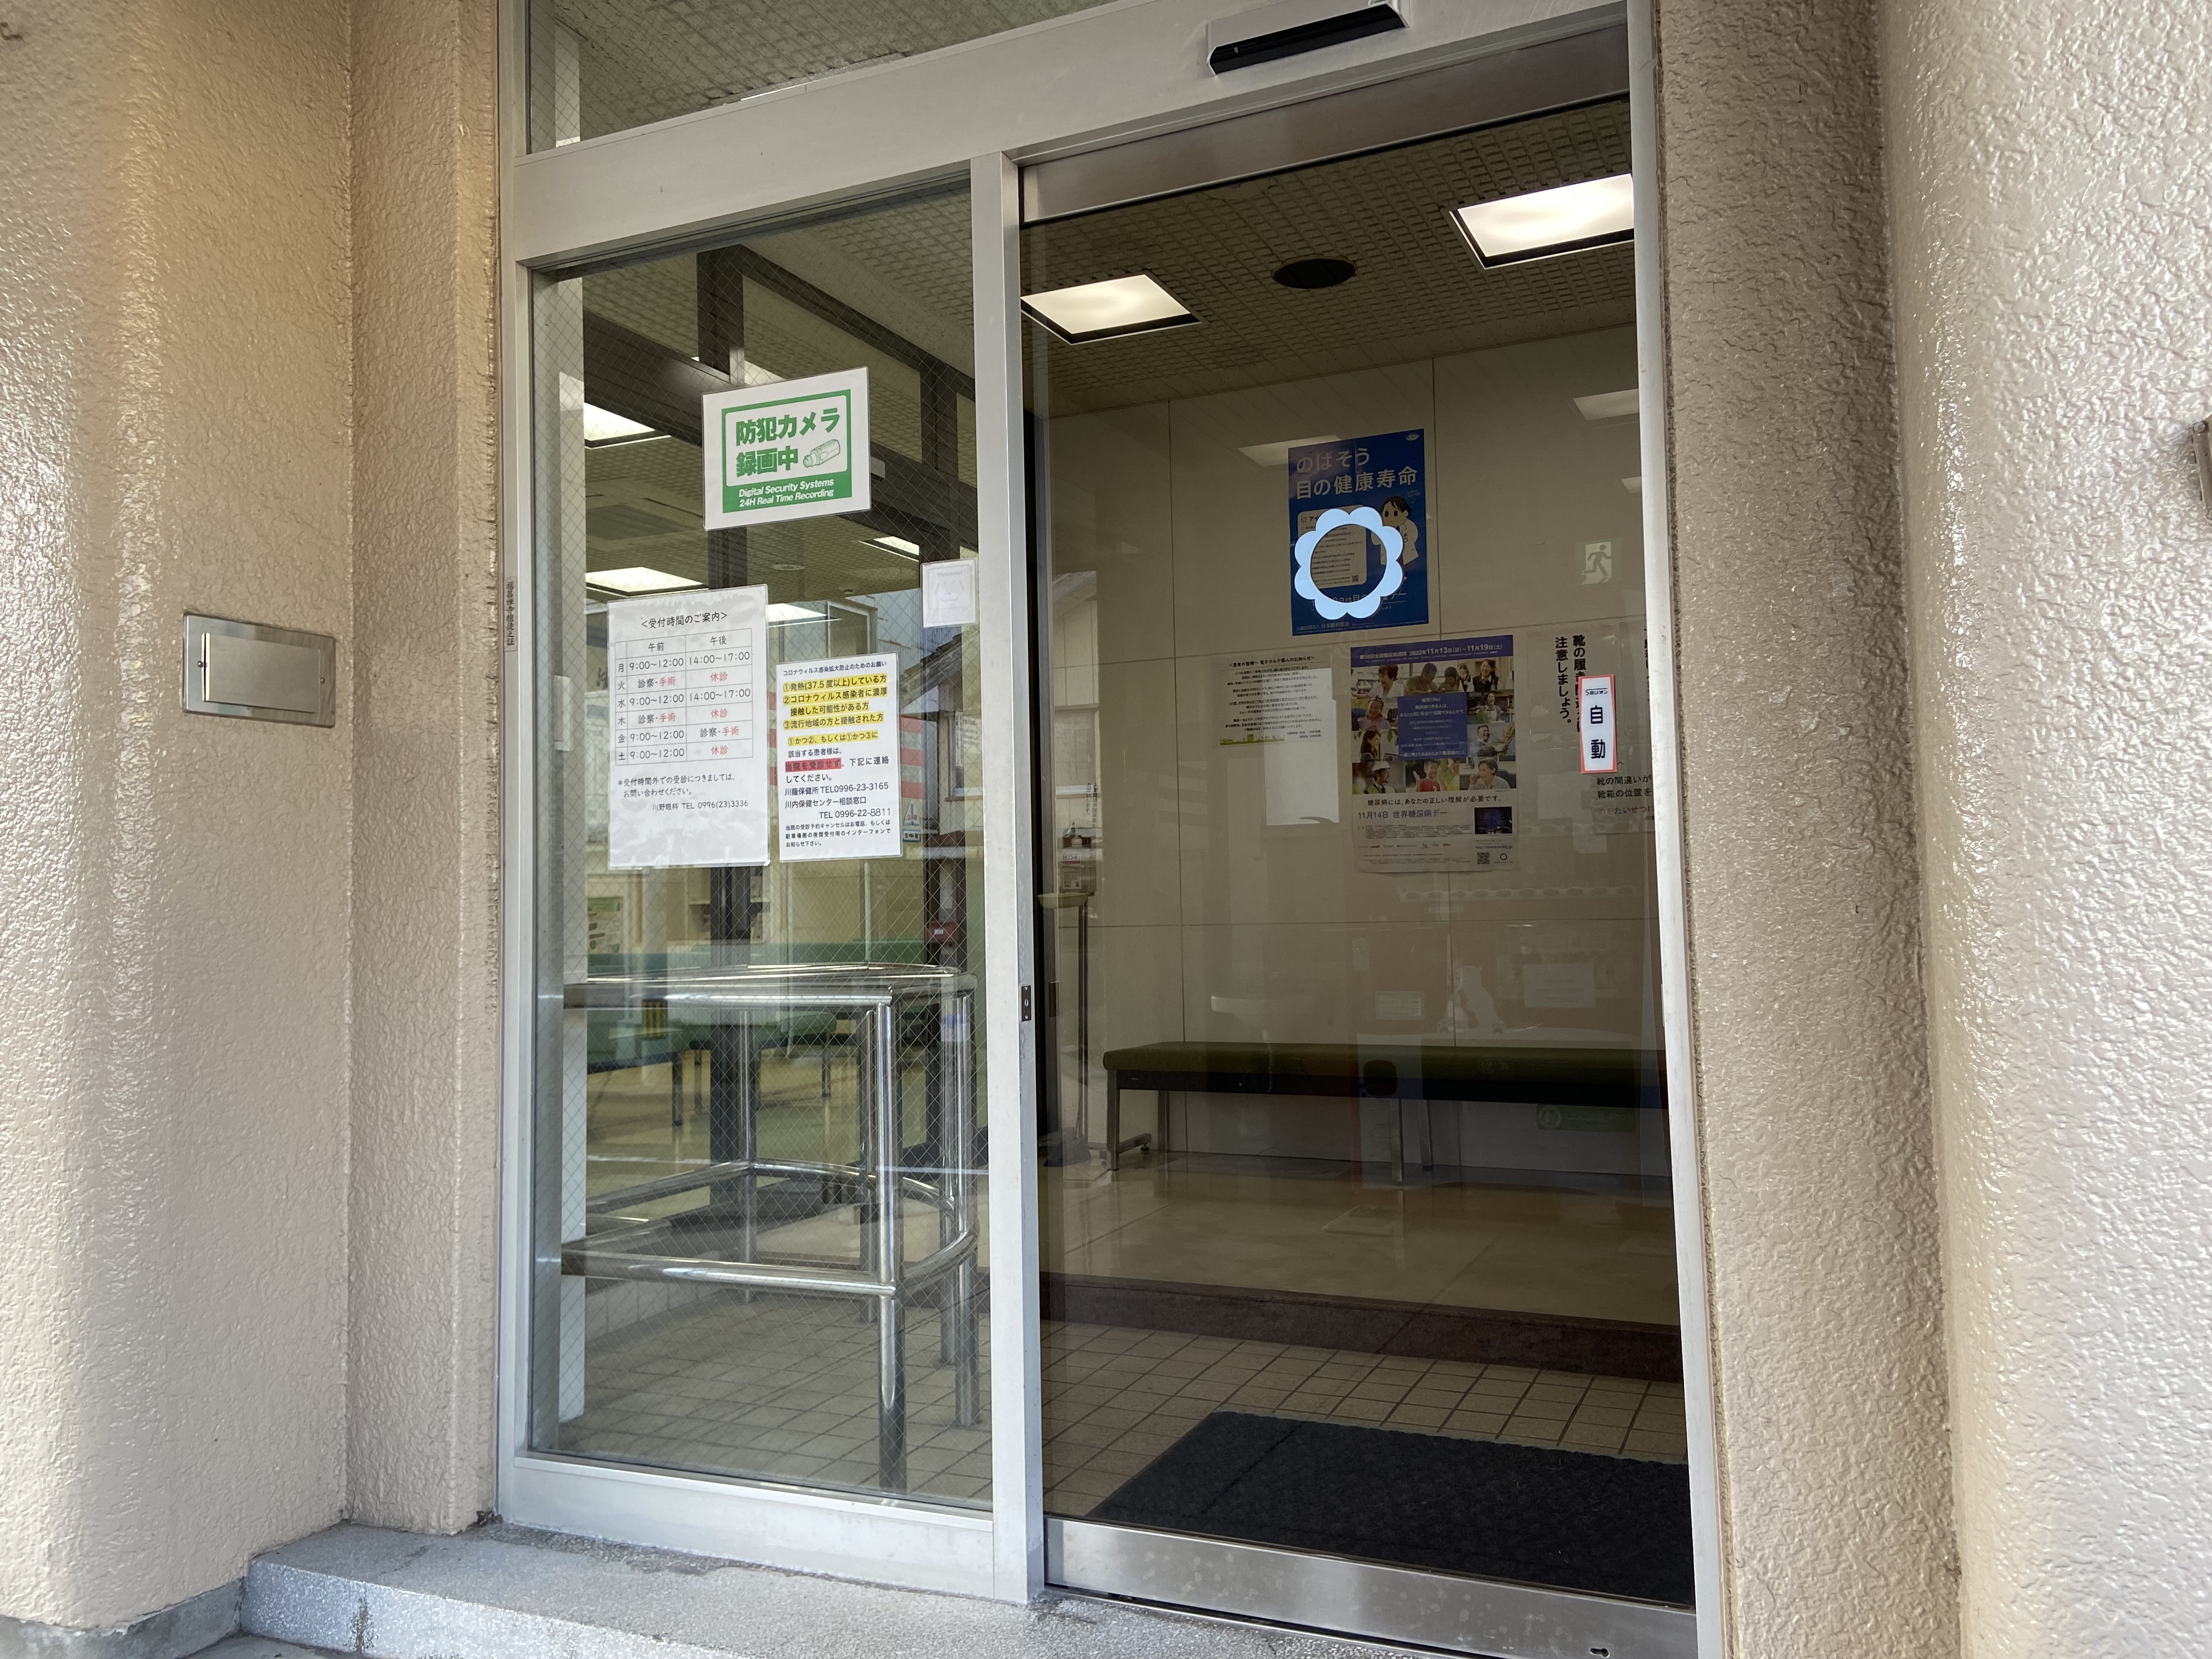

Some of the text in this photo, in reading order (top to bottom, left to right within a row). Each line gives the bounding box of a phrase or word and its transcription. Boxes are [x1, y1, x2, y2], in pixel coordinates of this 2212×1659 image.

[736, 408, 840, 446] 防犯カメラ
[736, 445, 798, 477] 録画中
[1296, 448, 1370, 473] のばそう
[738, 478, 834, 498] Digital Security Systems
[1296, 466, 1417, 499] 目の健康寿命
[739, 489, 834, 507] 24H Real Time Recording
[648, 636, 727, 651] 午前 午後
[618, 663, 624, 673] 月
[783, 661, 887, 676] コロナウィルス感染拡大防止のためのお願い
[618, 672, 728, 690] 火 診察・手術 休診
[1555, 636, 1571, 724] 注意しましょう。
[617, 698, 626, 708] 水
[790, 702, 869, 716] 接触した可能性がある方
[617, 708, 728, 725] 木 診察・手術 休診
[618, 734, 626, 743] 金
[699, 726, 740, 737] 診察・手術
[1590, 705, 1605, 759] 自動
[618, 752, 626, 761] 土
[711, 745, 729, 755] 休診
[788, 747, 842, 758] 該当する患者様は、
[786, 774, 832, 783] してください。
[1596, 774, 1652, 785] 靴の間違いが
[623, 788, 692, 798] お問い合わせください。
[820, 782, 889, 793] TEL0996-23-3165
[1598, 788, 1652, 799] 靴箱の位置を
[652, 803, 678, 811] 川野眼科
[698, 800, 748, 809] 0996(23)3336
[785, 797, 866, 809] 川内保健センター相談窓口
[1367, 795, 1502, 806] 糖尿病には、あなたの正しい理解が必要です。
[835, 808, 890, 818] 0996-22-8811
[1392, 809, 1447, 819] 世界糖尿病デー
